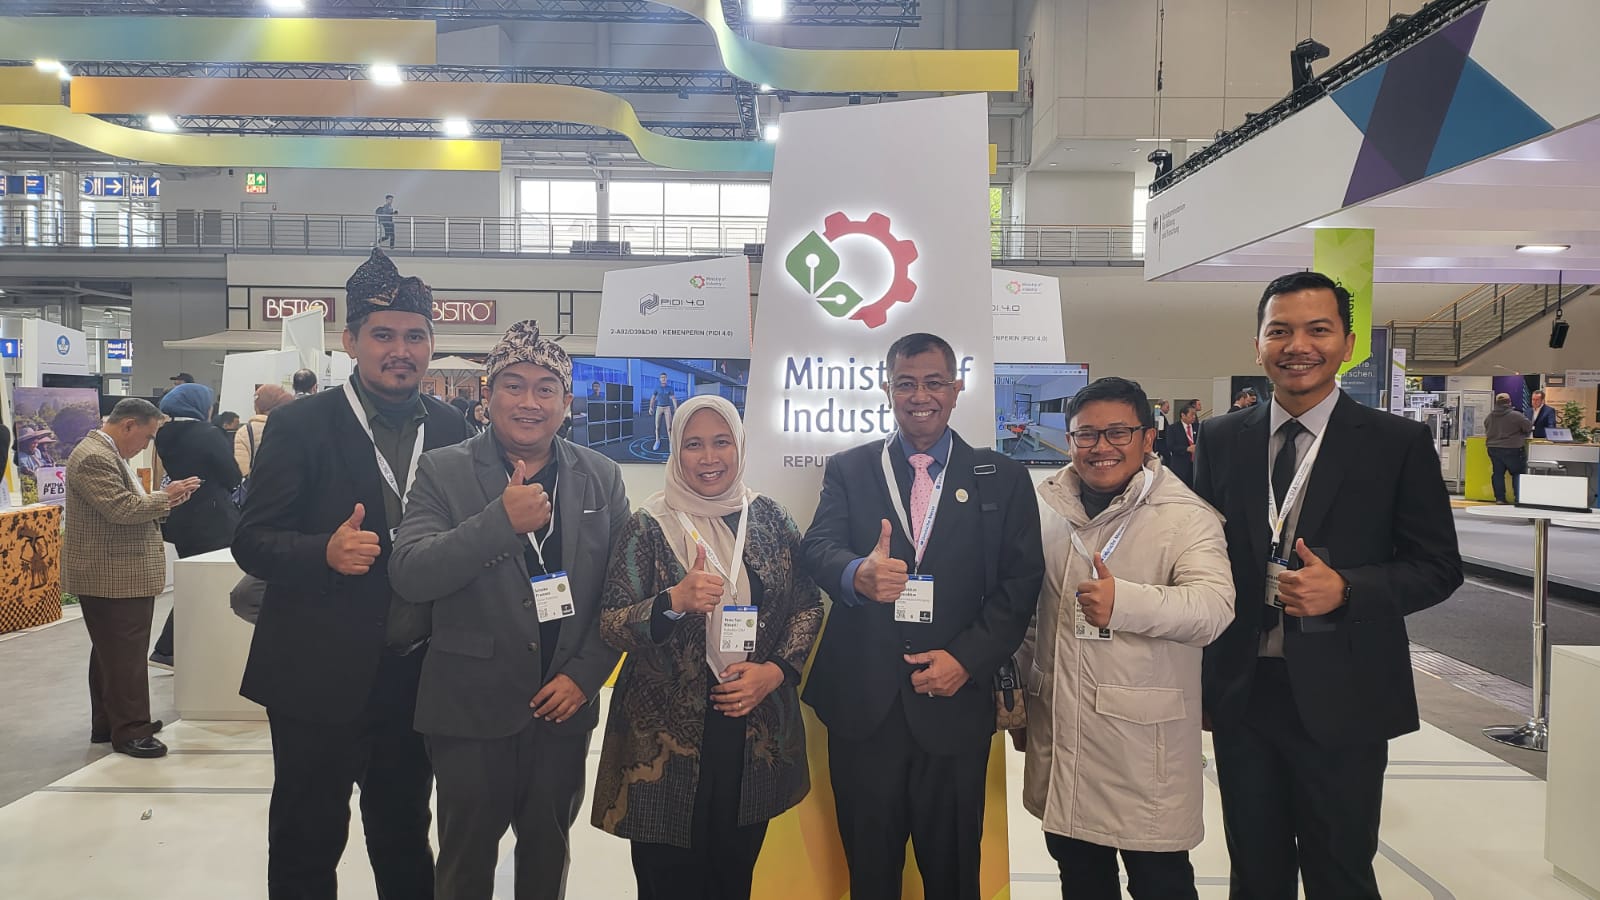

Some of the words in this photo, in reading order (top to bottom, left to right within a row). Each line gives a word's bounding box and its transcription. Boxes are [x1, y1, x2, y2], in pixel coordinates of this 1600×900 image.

[266, 299, 328, 318] BISTRO
[432, 302, 490, 321] BISTRO
[784, 356, 889, 390] Minist
[957, 356, 975, 391] f
[783, 398, 899, 433] Indust
[783, 455, 832, 468] REPU
